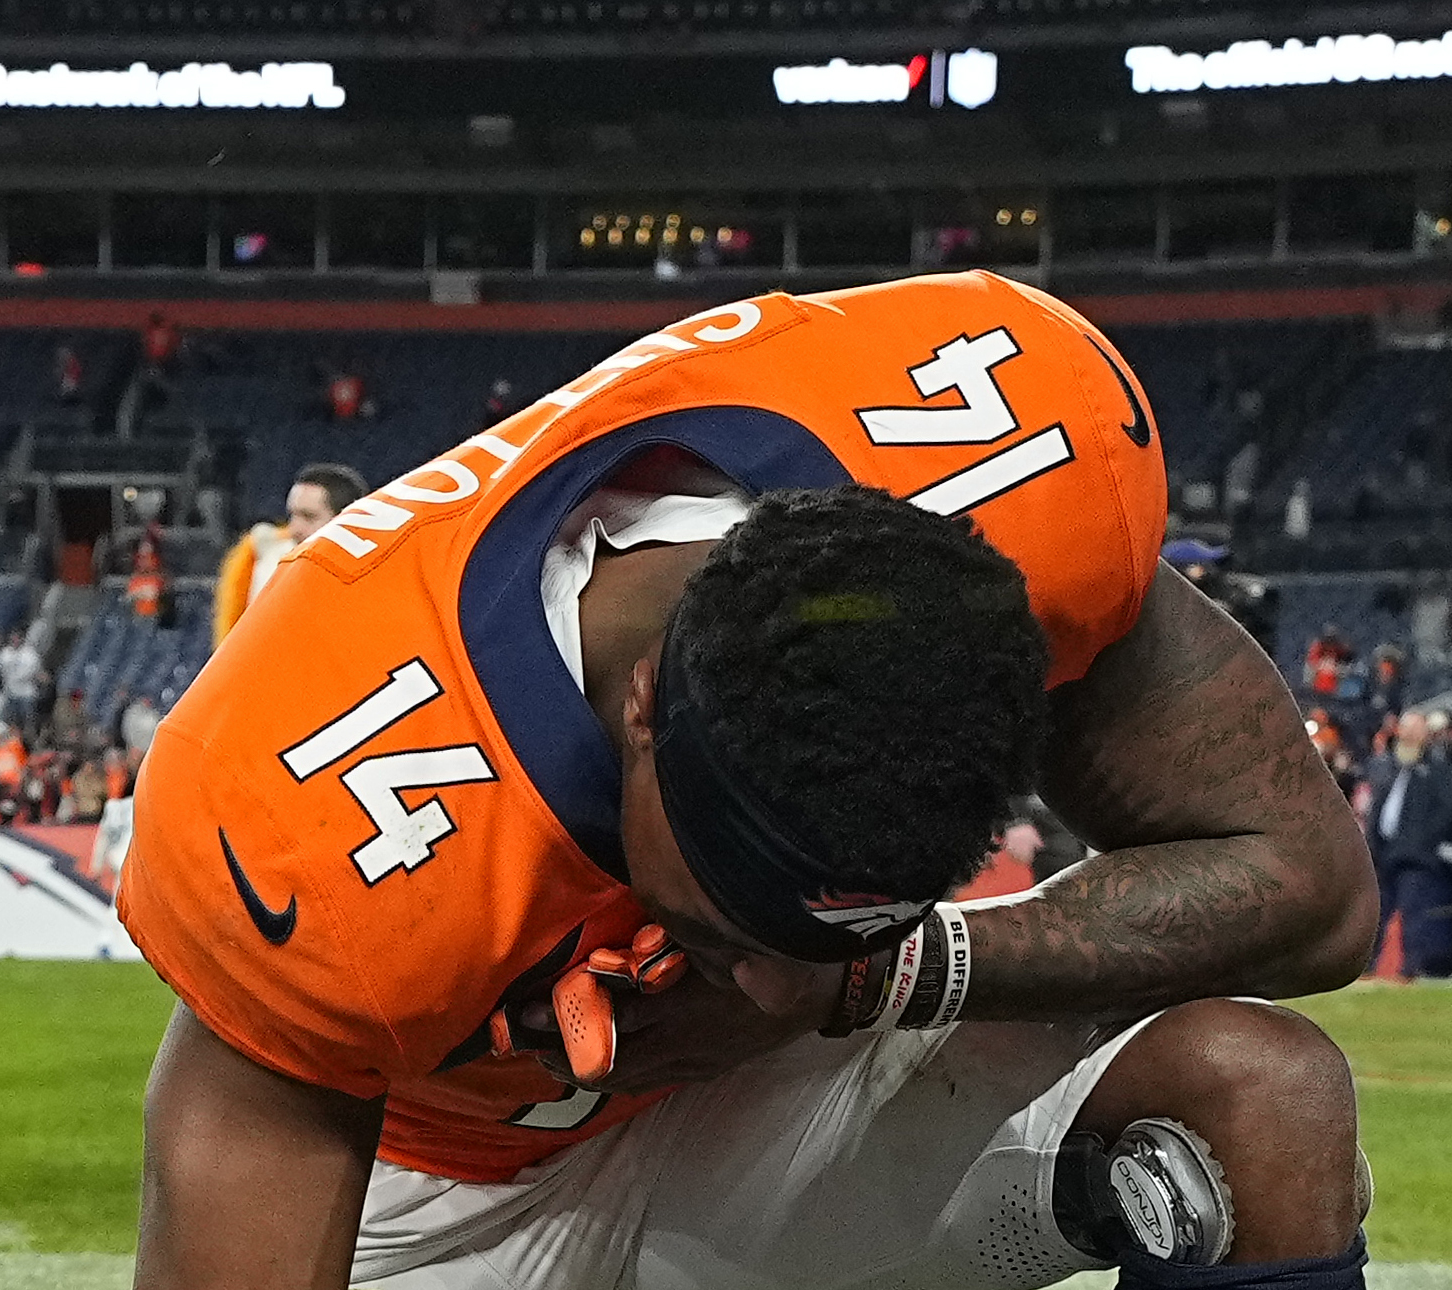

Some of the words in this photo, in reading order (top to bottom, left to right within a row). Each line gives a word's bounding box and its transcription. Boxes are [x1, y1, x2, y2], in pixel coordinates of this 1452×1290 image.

[854, 325, 1076, 518] 14
[279, 657, 499, 887] 14
[902, 937, 917, 969] THE
[950, 921, 966, 944] BE
[892, 972, 913, 1010] KING
[1117, 1161, 1171, 1251] DONJOY
